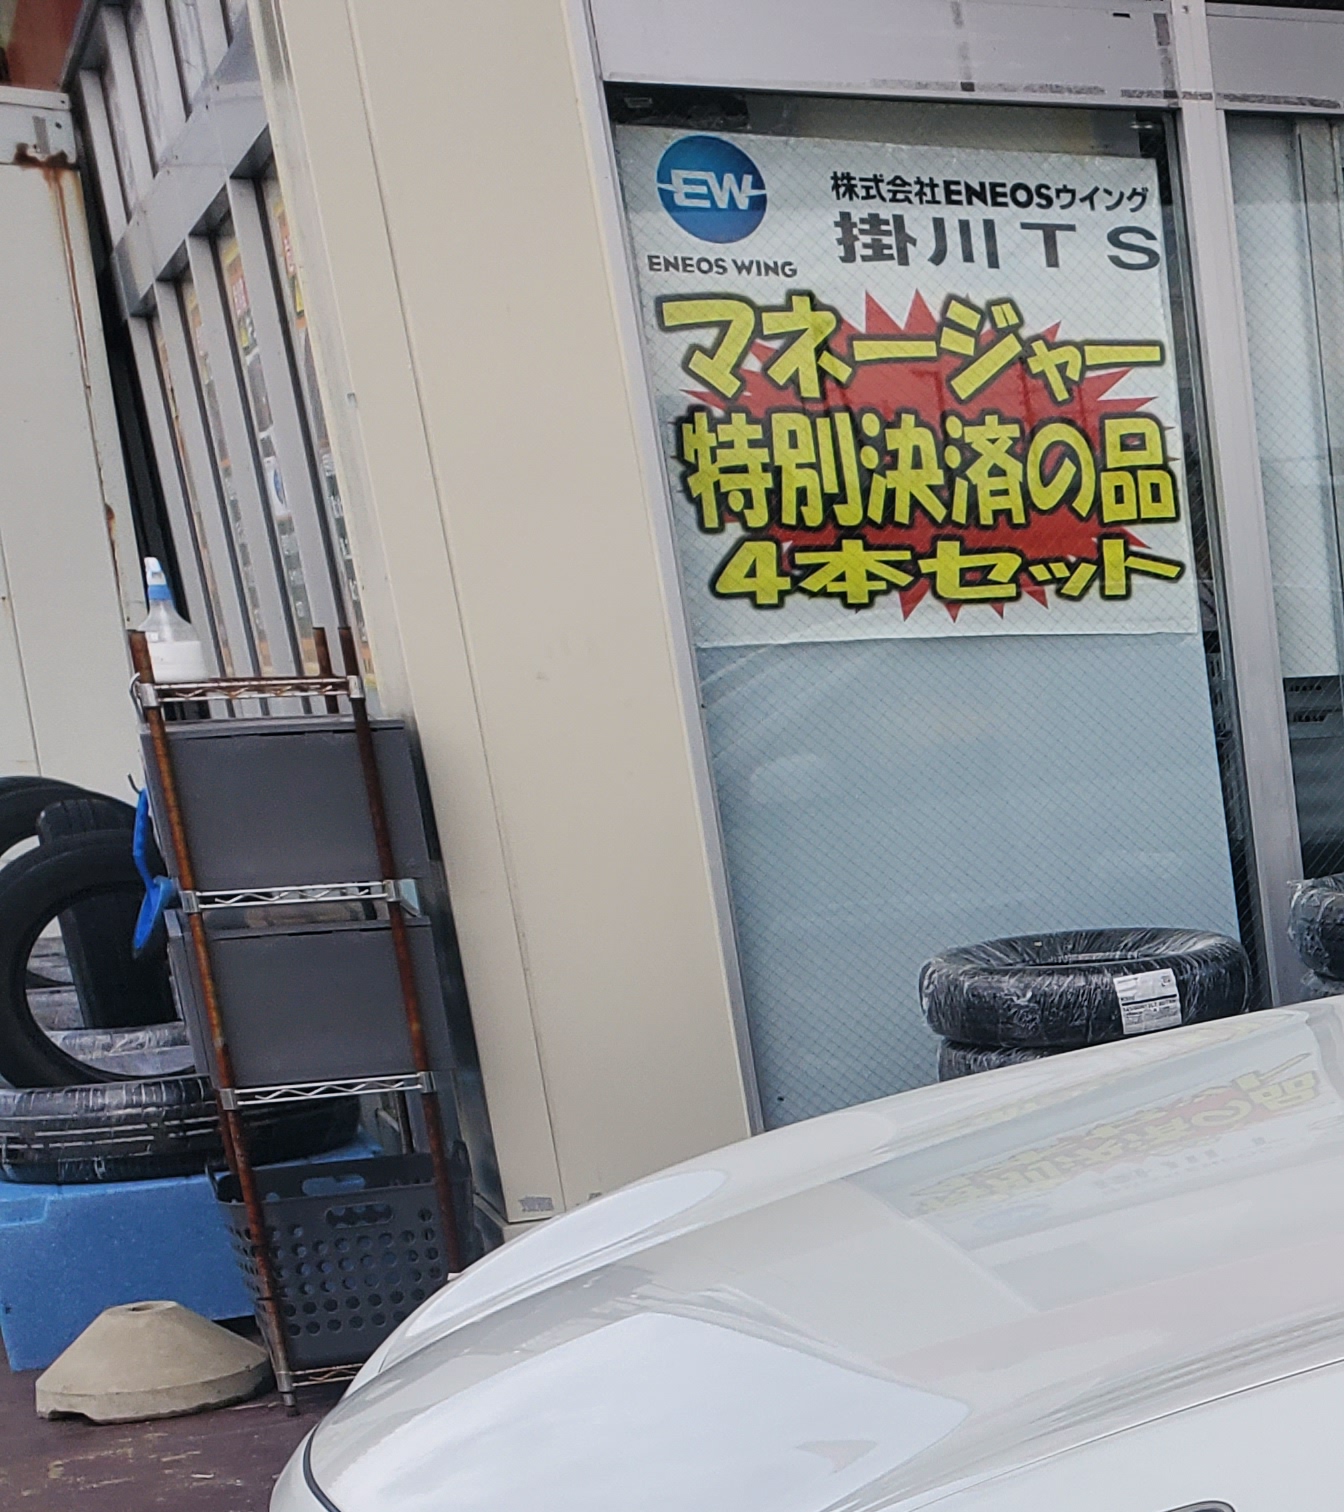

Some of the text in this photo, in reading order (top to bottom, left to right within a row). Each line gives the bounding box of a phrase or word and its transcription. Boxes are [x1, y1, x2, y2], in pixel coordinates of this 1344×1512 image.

[671, 168, 755, 211] EW
[829, 171, 1150, 214] 株式会社ENEOSウイング
[646, 253, 798, 279] ENEOS WING
[656, 289, 1167, 403] マネージャー
[676, 406, 1182, 532] 特別決済の品
[710, 534, 1186, 610] 4本セット
